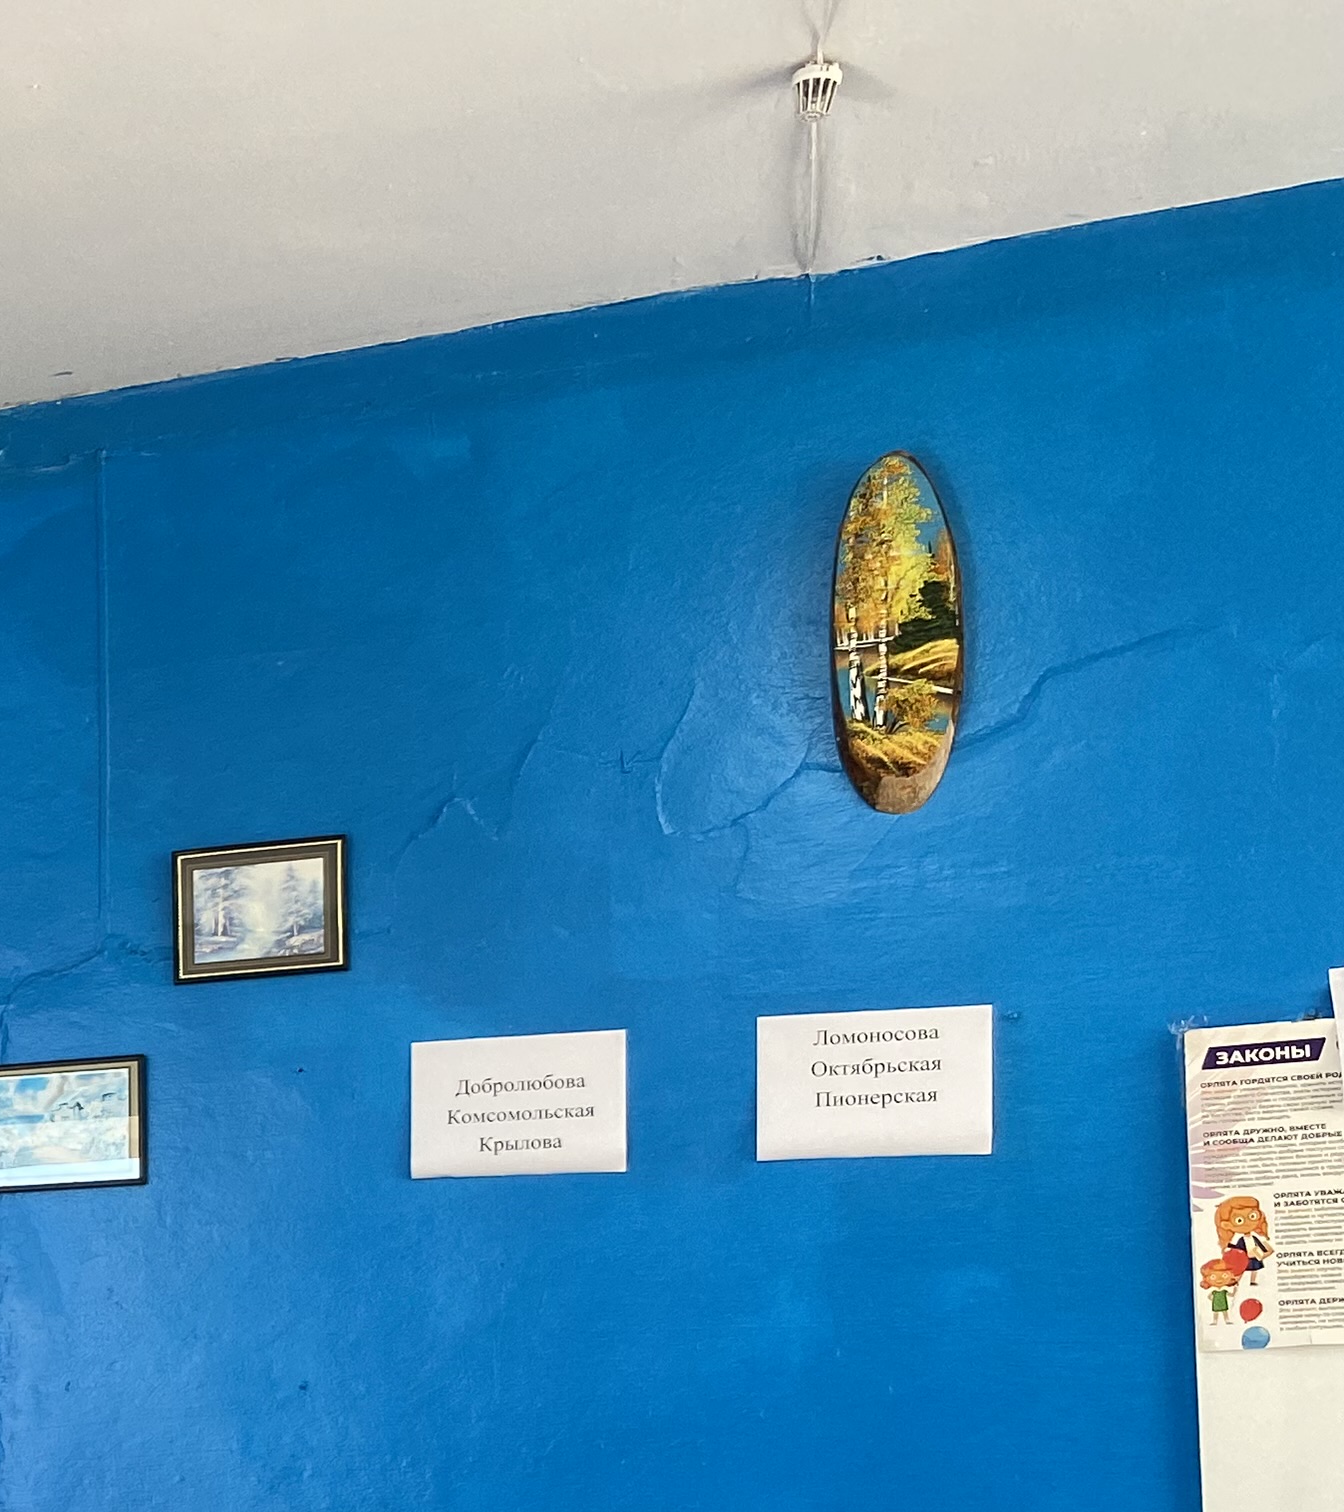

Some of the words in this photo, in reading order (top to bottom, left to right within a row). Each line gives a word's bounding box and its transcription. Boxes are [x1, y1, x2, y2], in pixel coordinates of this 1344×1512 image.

[812, 1027, 940, 1046] Ломоносова
[1215, 1044, 1311, 1066] ЗАКОНЫ
[811, 1058, 943, 1078] Октябрьская
[455, 1074, 586, 1098] Добролюбова
[1200, 1080, 1238, 1089] ОРЛЯТА
[1240, 1076, 1288, 1086] ГОРДЯТСЯ
[1291, 1072, 1323, 1081] СВОЕЙ
[815, 1089, 938, 1109] Пионерская
[447, 1105, 595, 1125] Комсомольская
[1202, 1129, 1240, 1139] ОРЛЯТА
[1289, 1123, 1327, 1132] ВМЕСТЕ
[1212, 1136, 1254, 1146] СООБЩА
[1257, 1133, 1299, 1143] ДЕЛАЮТ
[1301, 1130, 1343, 1140] ДОБРЫЕ
[479, 1136, 562, 1155] Крылова
[1273, 1191, 1311, 1199] ОРЛЯТА
[1283, 1197, 1339, 1207] ЗАБОТЯТСЯ
[1276, 1251, 1314, 1259] ОРЛЯТА
[1277, 1259, 1321, 1268] УЧИТЬСЯ
[1323, 1257, 1344, 1265] НОВ
[1278, 1298, 1317, 1307] ОРЛЯТА
